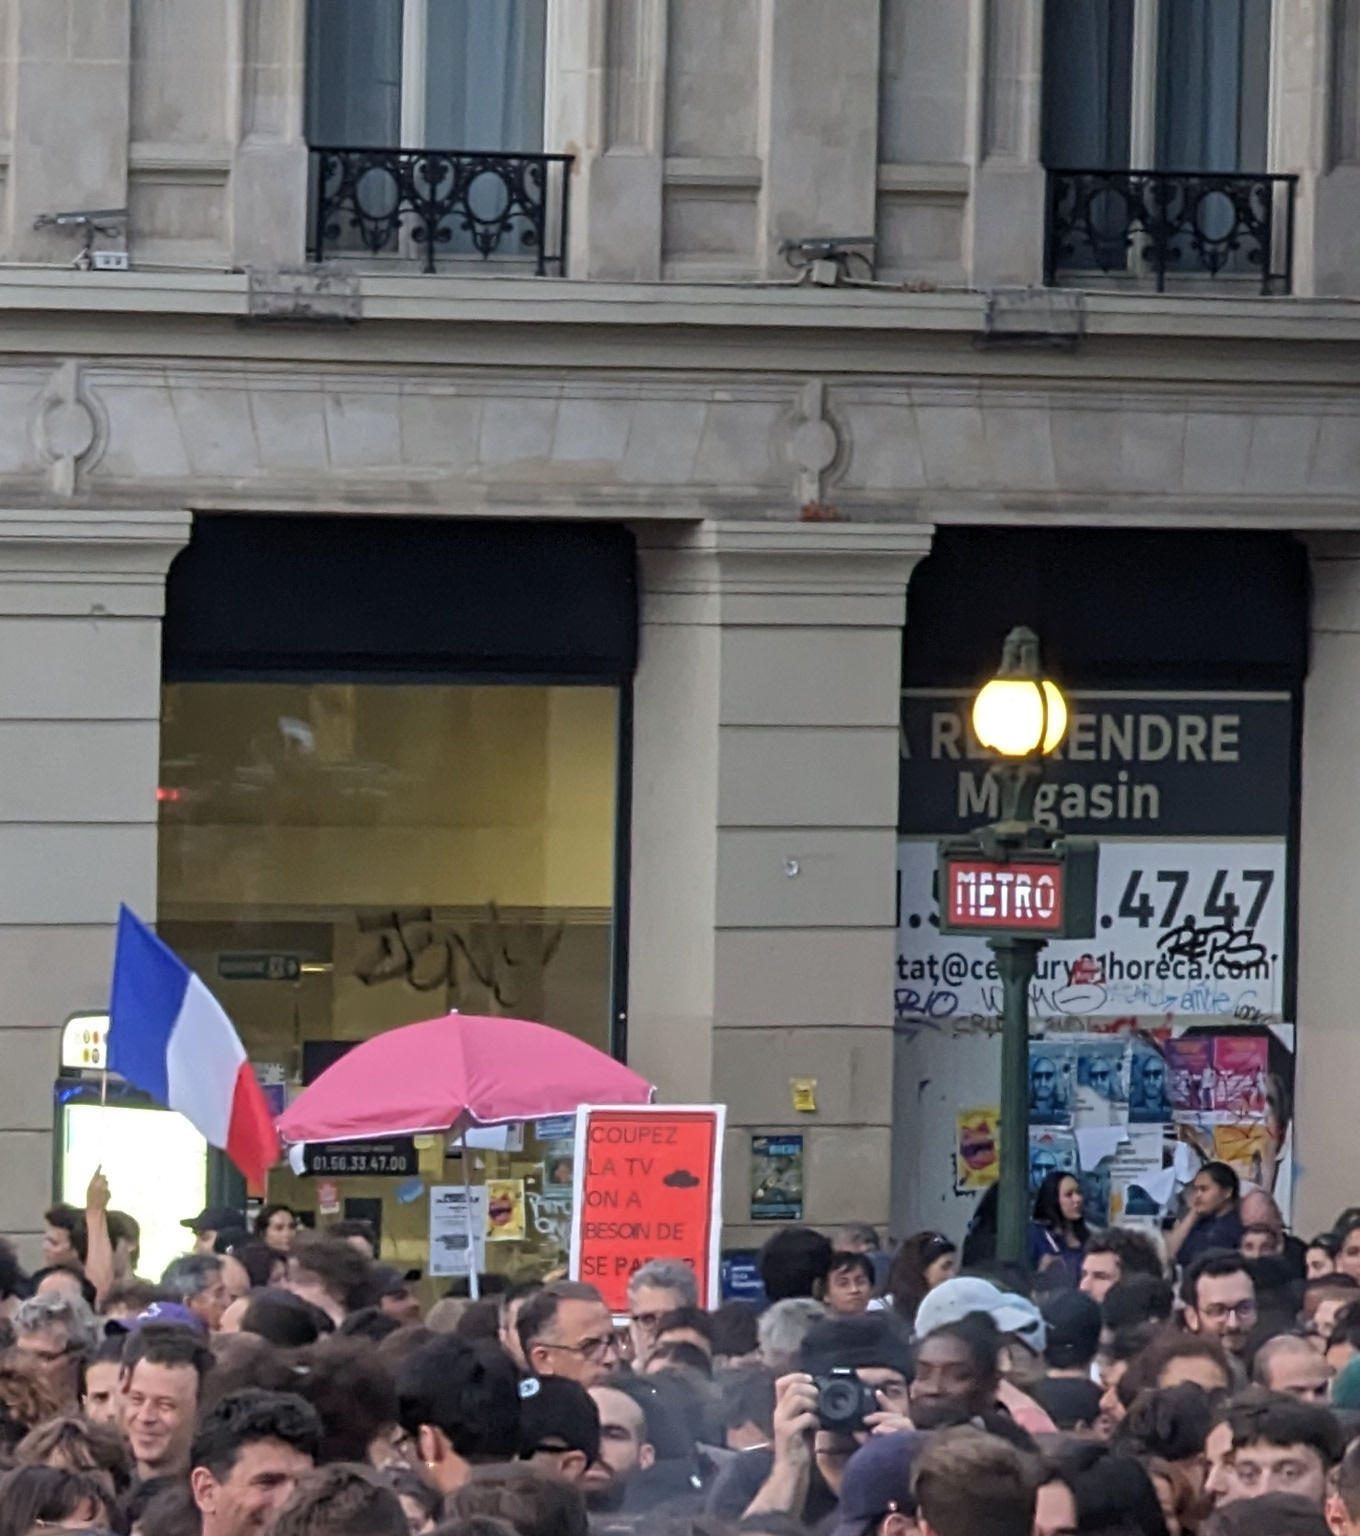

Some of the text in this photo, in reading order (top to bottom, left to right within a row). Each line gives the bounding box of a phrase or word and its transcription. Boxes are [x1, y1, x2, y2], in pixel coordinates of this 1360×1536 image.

[931, 712, 1240, 762] REENDRE
[958, 770, 1160, 831] Mgasin
[956, 871, 1054, 919] METRO
[590, 1126, 678, 1144] COUPEZ
[588, 1158, 654, 1176] LA TV
[587, 1190, 641, 1208] ON A
[586, 1222, 685, 1240] BESOIN DE
[583, 1256, 608, 1276] SE
